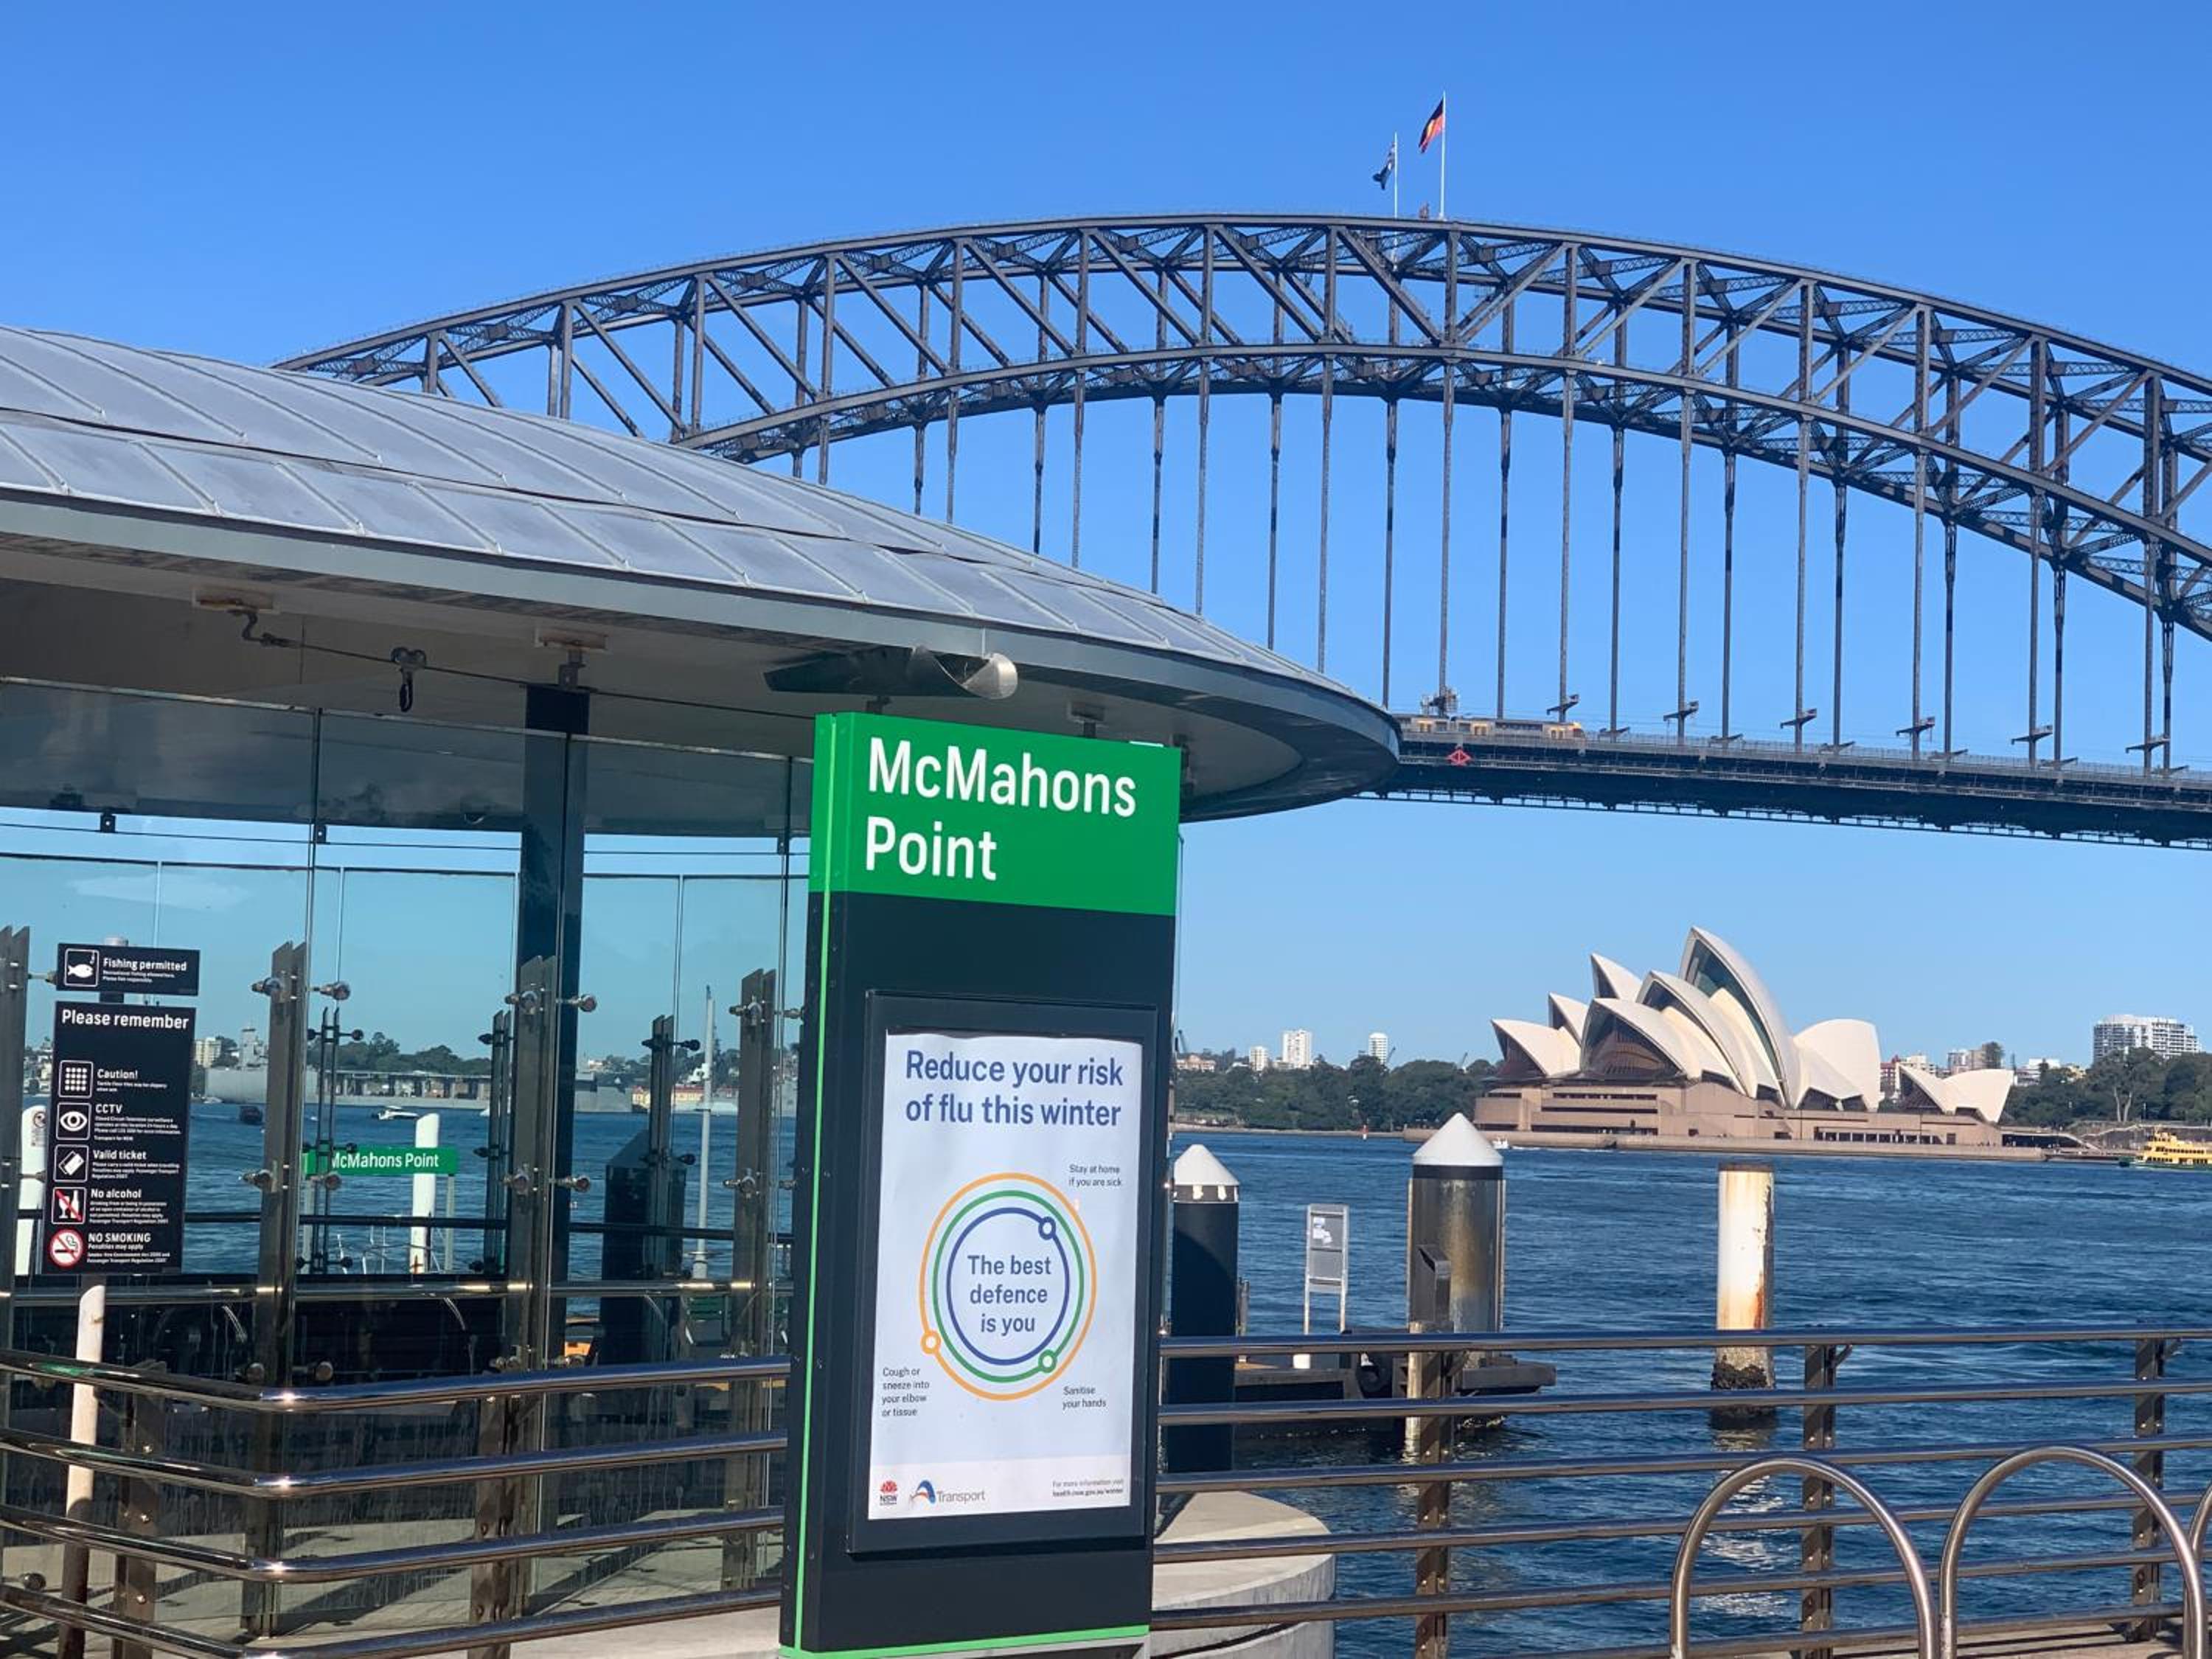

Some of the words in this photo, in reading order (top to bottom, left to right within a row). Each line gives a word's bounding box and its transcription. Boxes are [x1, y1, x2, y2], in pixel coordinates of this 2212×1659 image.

[869, 737, 1136, 818] McMahons
[866, 815, 996, 880] Point
[102, 958, 138, 970] Fishing
[139, 961, 187, 972] permitted
[62, 1009, 111, 1026] Please
[114, 1014, 189, 1029] remember
[97, 1068, 138, 1079] Caution!
[905, 1050, 1005, 1082] Reduce
[1012, 1061, 1071, 1088] your
[1077, 1057, 1124, 1086] risk
[95, 1104, 123, 1114] CCTV
[905, 1093, 933, 1121] of
[939, 1093, 973, 1123] flu
[981, 1094, 1034, 1124] this
[1040, 1098, 1121, 1126] winter
[92, 1150, 117, 1160] Valid
[119, 1150, 147, 1160] ticket
[332, 1152, 402, 1169] McMahons
[406, 1152, 439, 1168] Point
[1068, 1164, 1088, 1175] Stay
[1099, 1164, 1120, 1173] home
[1068, 1177, 1074, 1186] if
[1077, 1179, 1091, 1188] you
[1107, 1177, 1121, 1186] sick
[91, 1189, 104, 1198] No
[106, 1189, 142, 1198] alcohol
[88, 1232, 103, 1242] NO
[105, 1232, 151, 1242] SMOKING
[967, 1255, 1004, 1275] The
[1010, 1255, 1051, 1275] best
[970, 1283, 1048, 1304] defence
[981, 1313, 997, 1333] is
[1001, 1317, 1035, 1337] you
[883, 1367, 911, 1378] Cough
[911, 1368, 920, 1376] or
[913, 1381, 930, 1389] into
[1063, 1386, 1096, 1396] Sanitise
[882, 1396, 900, 1405] your
[902, 1394, 927, 1403] elbow
[1062, 1401, 1080, 1411] your
[1082, 1398, 1107, 1408] hands
[893, 1408, 918, 1416] tissue
[936, 1490, 986, 1505] Transport
